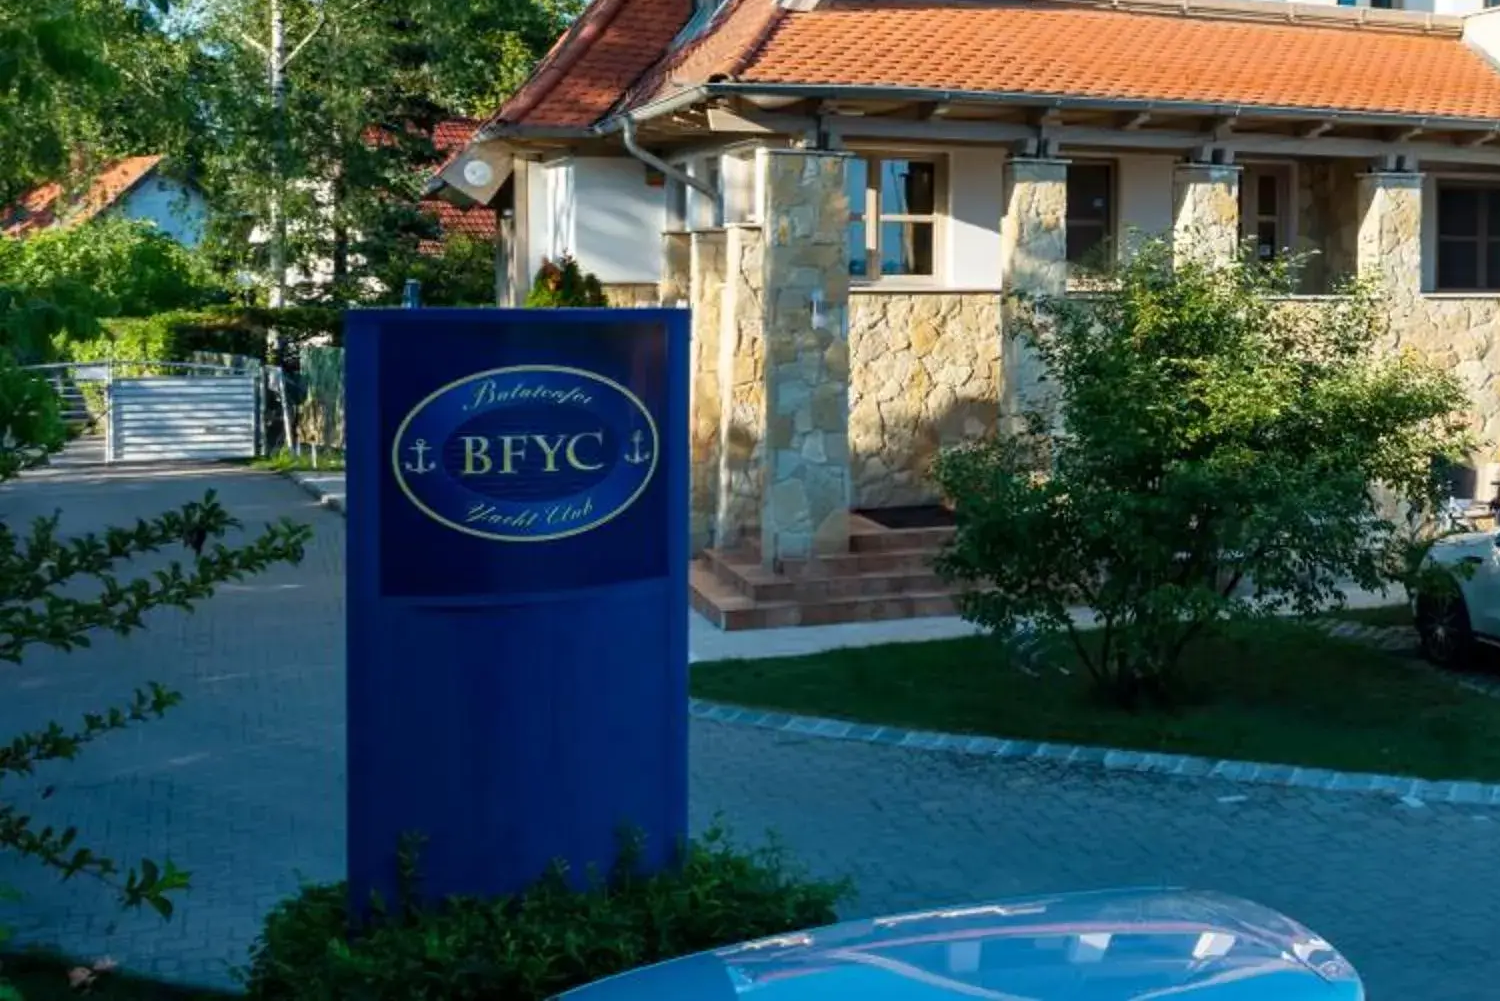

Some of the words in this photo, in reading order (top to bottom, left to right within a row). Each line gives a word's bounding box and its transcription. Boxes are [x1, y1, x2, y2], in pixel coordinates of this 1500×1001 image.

[460, 432, 604, 476] BFYC
[465, 503, 538, 527] Yacht
[543, 497, 593, 525] Club
